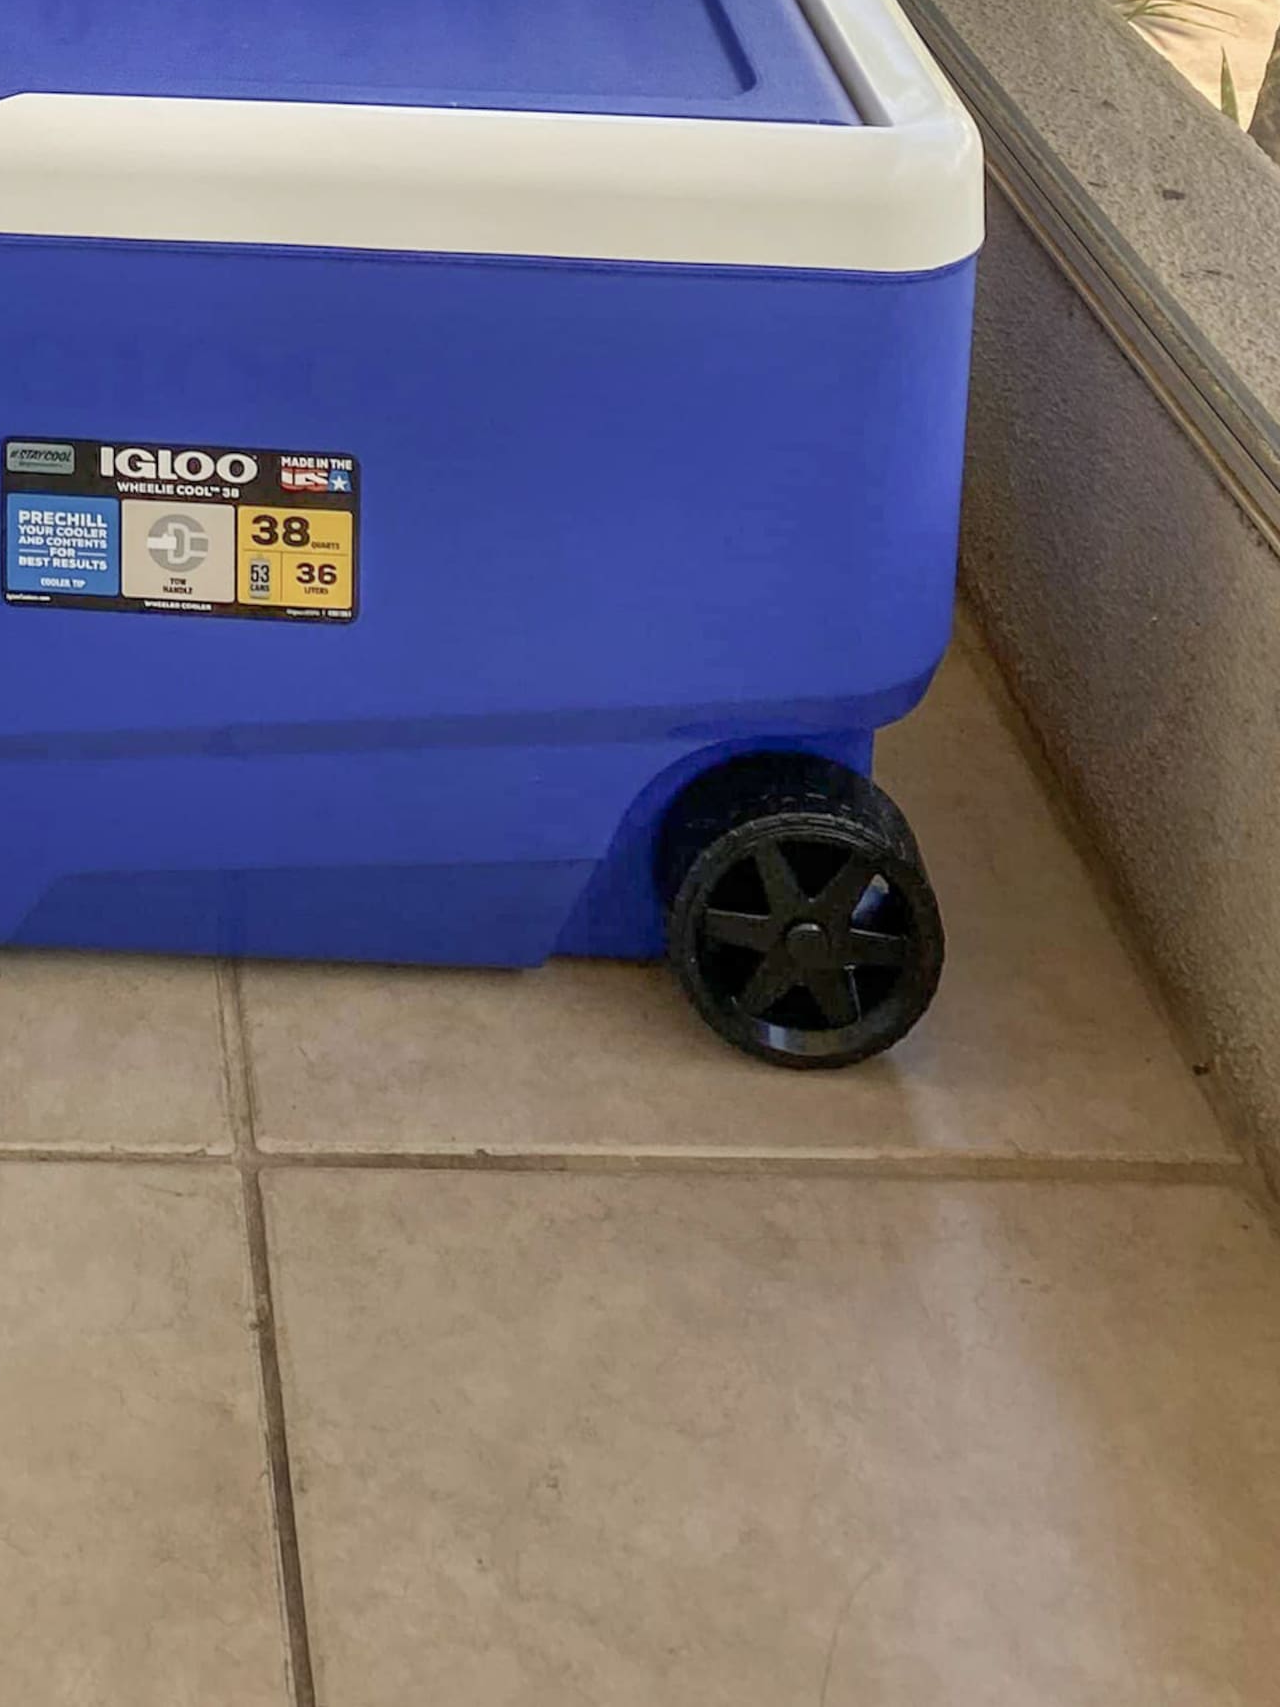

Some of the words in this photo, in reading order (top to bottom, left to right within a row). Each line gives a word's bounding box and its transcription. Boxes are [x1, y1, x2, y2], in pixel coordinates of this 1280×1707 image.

[100, 447, 258, 483] IGLOO
[281, 456, 314, 466] MADE
[316, 458, 328, 467] IN
[329, 459, 352, 469] THE
[117, 481, 174, 494] WHEELIE
[222, 488, 239, 497] 38
[18, 510, 107, 527] PRECHILL
[18, 525, 54, 536] YOUR
[56, 527, 107, 539] COOLER
[252, 514, 310, 547] 38
[18, 536, 44, 545] AND
[46, 538, 107, 548] CONTENTS
[311, 541, 339, 550] QUARTS
[49, 548, 76, 557] FOR
[18, 557, 49, 567] BEST
[53, 558, 107, 570] RESULTS
[250, 565, 270, 582] 53
[296, 563, 337, 585] 36
[41, 577, 70, 587] COOLER
[250, 583, 269, 592] CANS
[304, 586, 328, 595] LITERS
